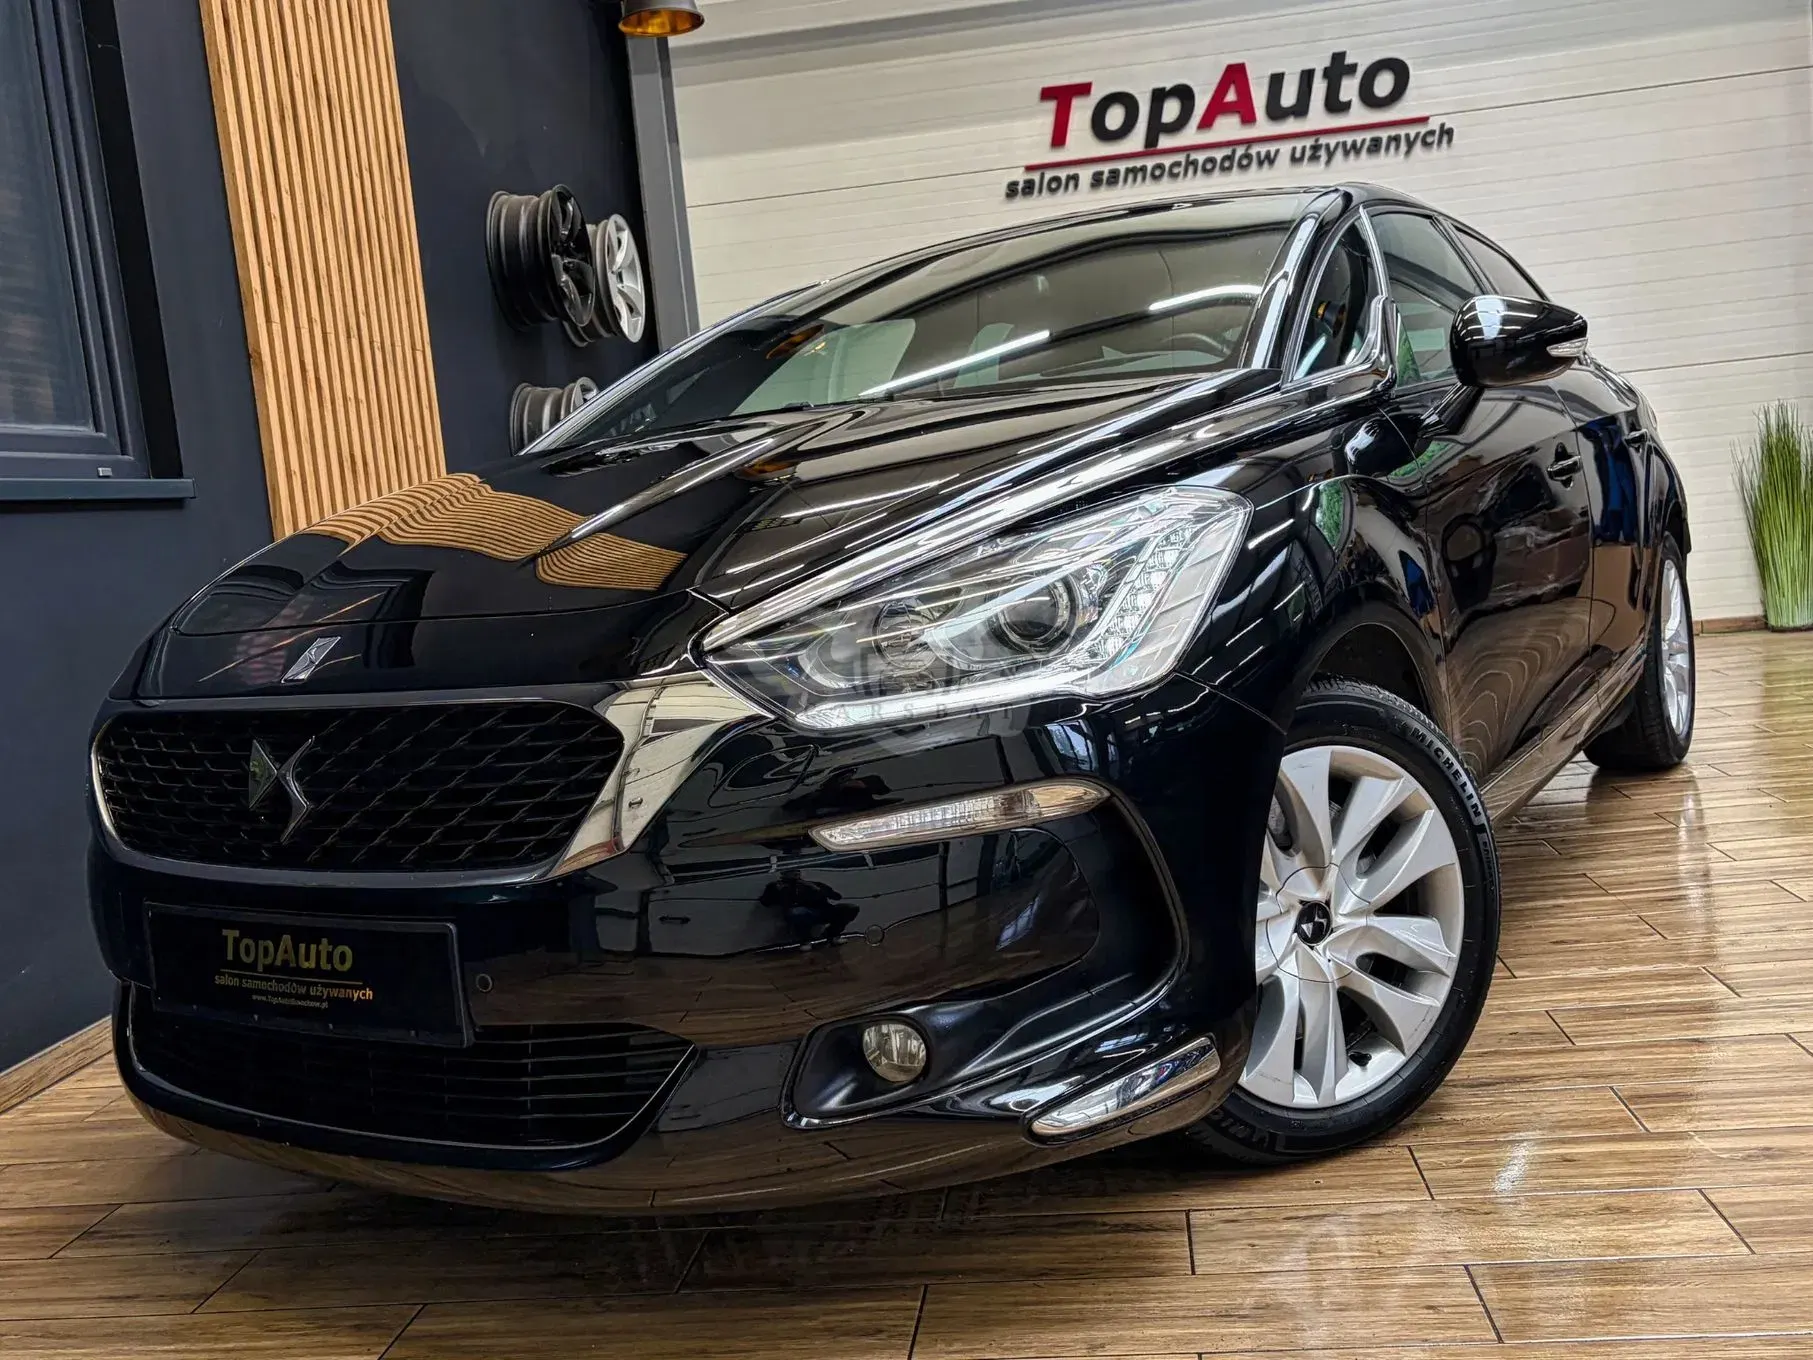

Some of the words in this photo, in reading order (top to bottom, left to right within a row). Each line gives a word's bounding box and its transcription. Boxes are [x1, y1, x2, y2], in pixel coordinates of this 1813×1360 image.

[1040, 50, 1412, 149] TopAuto
[1005, 171, 1081, 199] salon
[1090, 145, 1281, 189] samochodów
[1289, 122, 1455, 168] używanych
[1410, 727, 1482, 819] MICHELIN
[214, 973, 240, 987] salon
[241, 979, 307, 995] samochodów
[309, 984, 374, 1002] używanych
[222, 929, 353, 972] TopAuto
